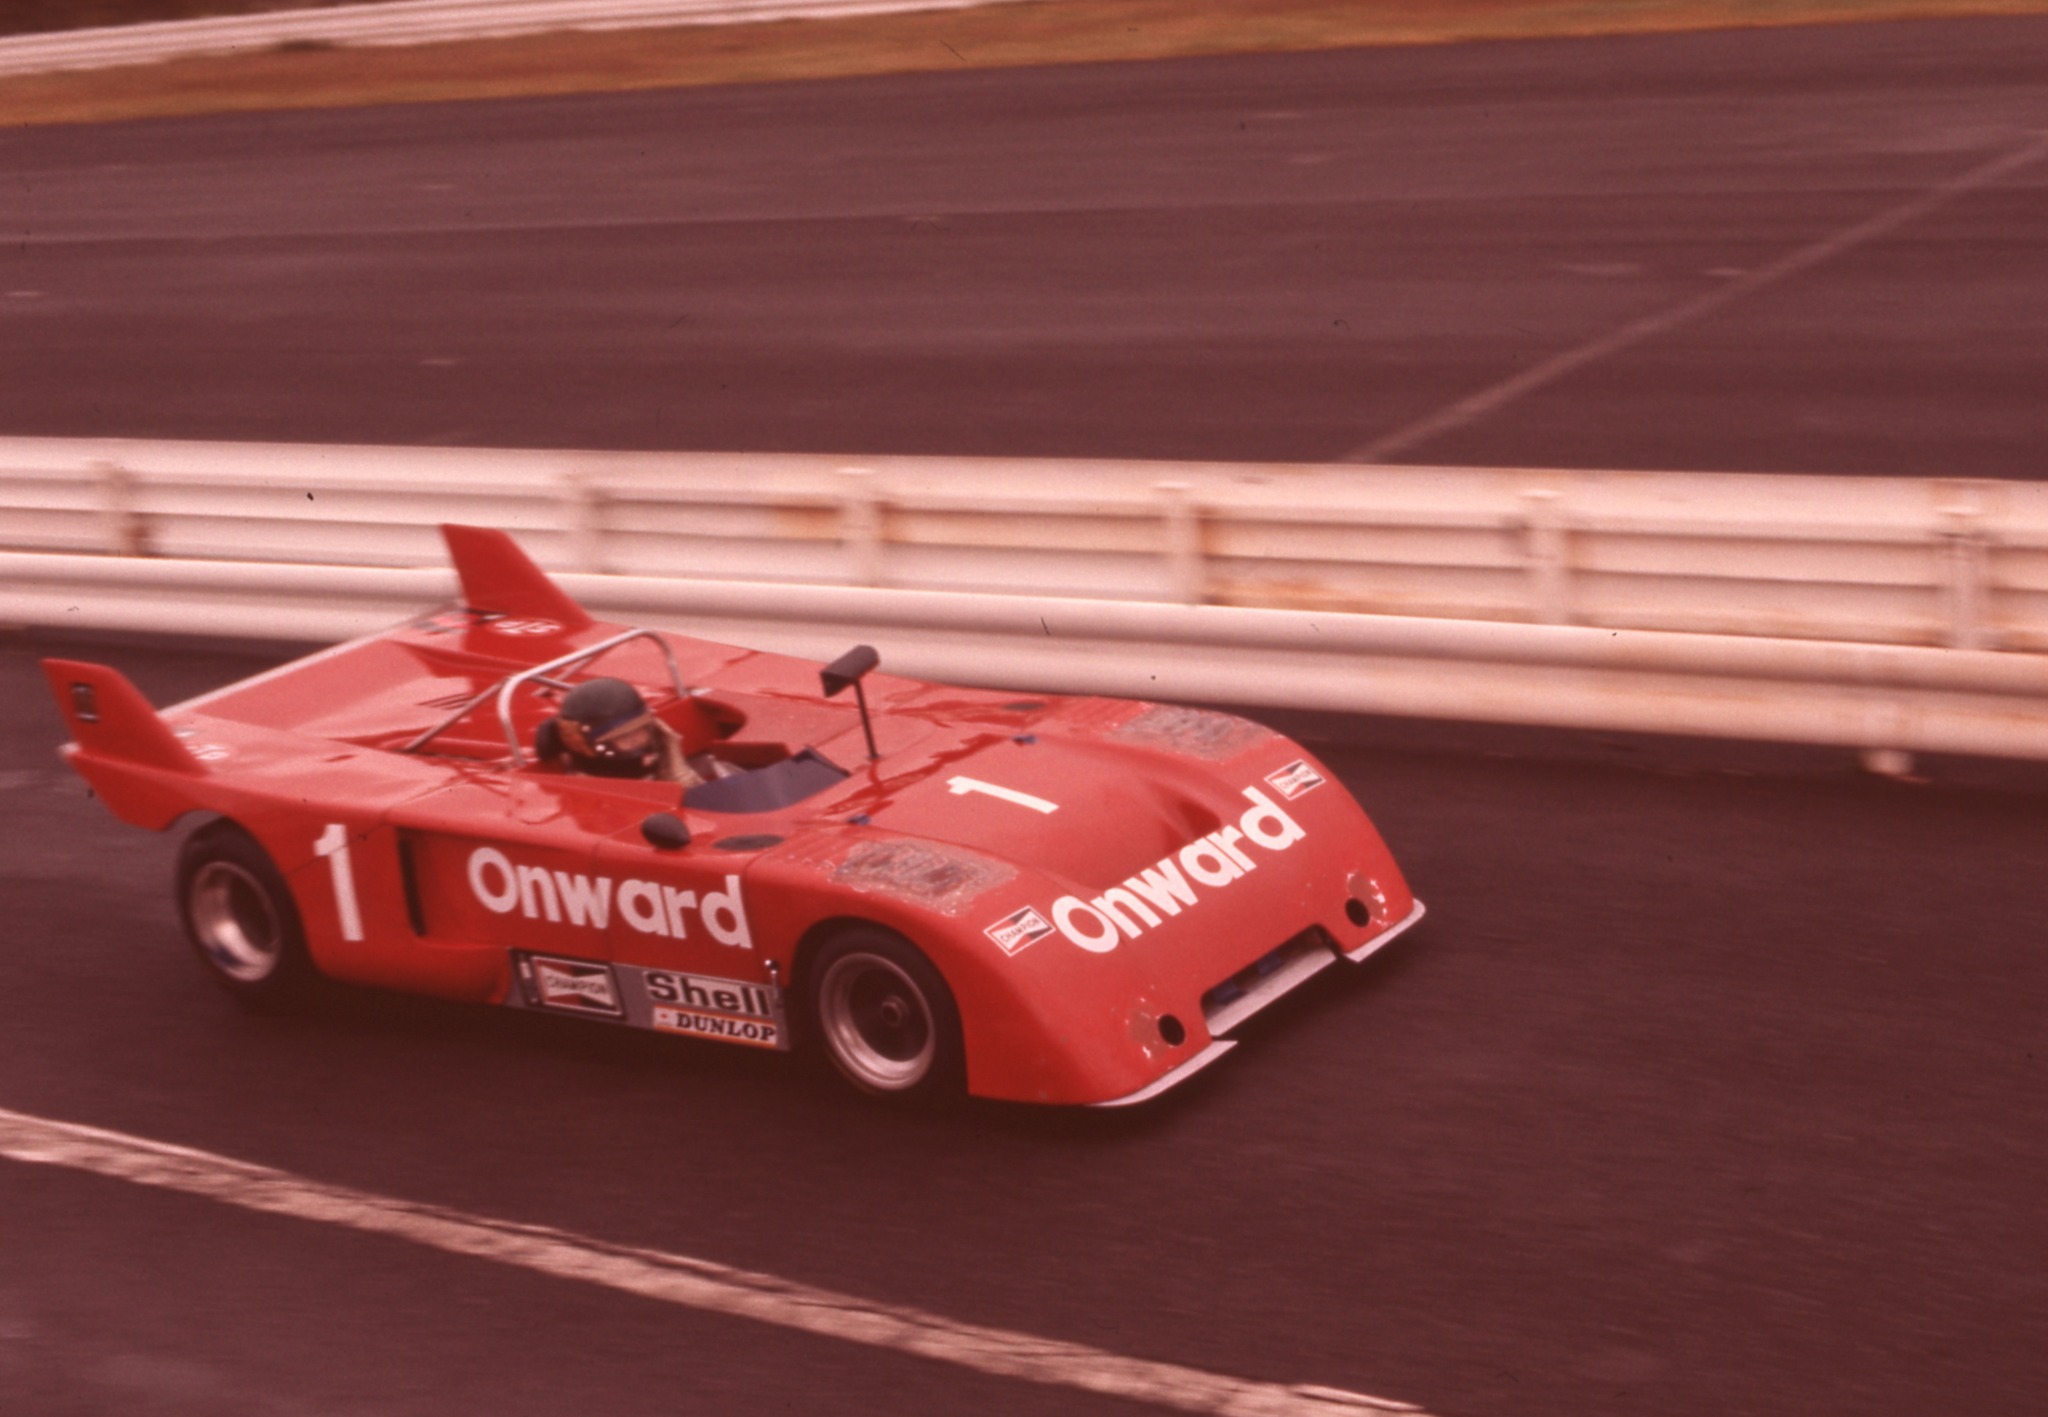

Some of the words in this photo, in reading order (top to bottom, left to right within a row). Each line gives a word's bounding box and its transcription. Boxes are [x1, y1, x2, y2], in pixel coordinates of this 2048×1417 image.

[947, 775, 1059, 814] 1
[313, 823, 364, 941] 1
[467, 847, 752, 949] Onward
[1052, 786, 1306, 953] Onward
[646, 972, 770, 1015] Shell
[676, 1012, 775, 1041] DUNLOP
